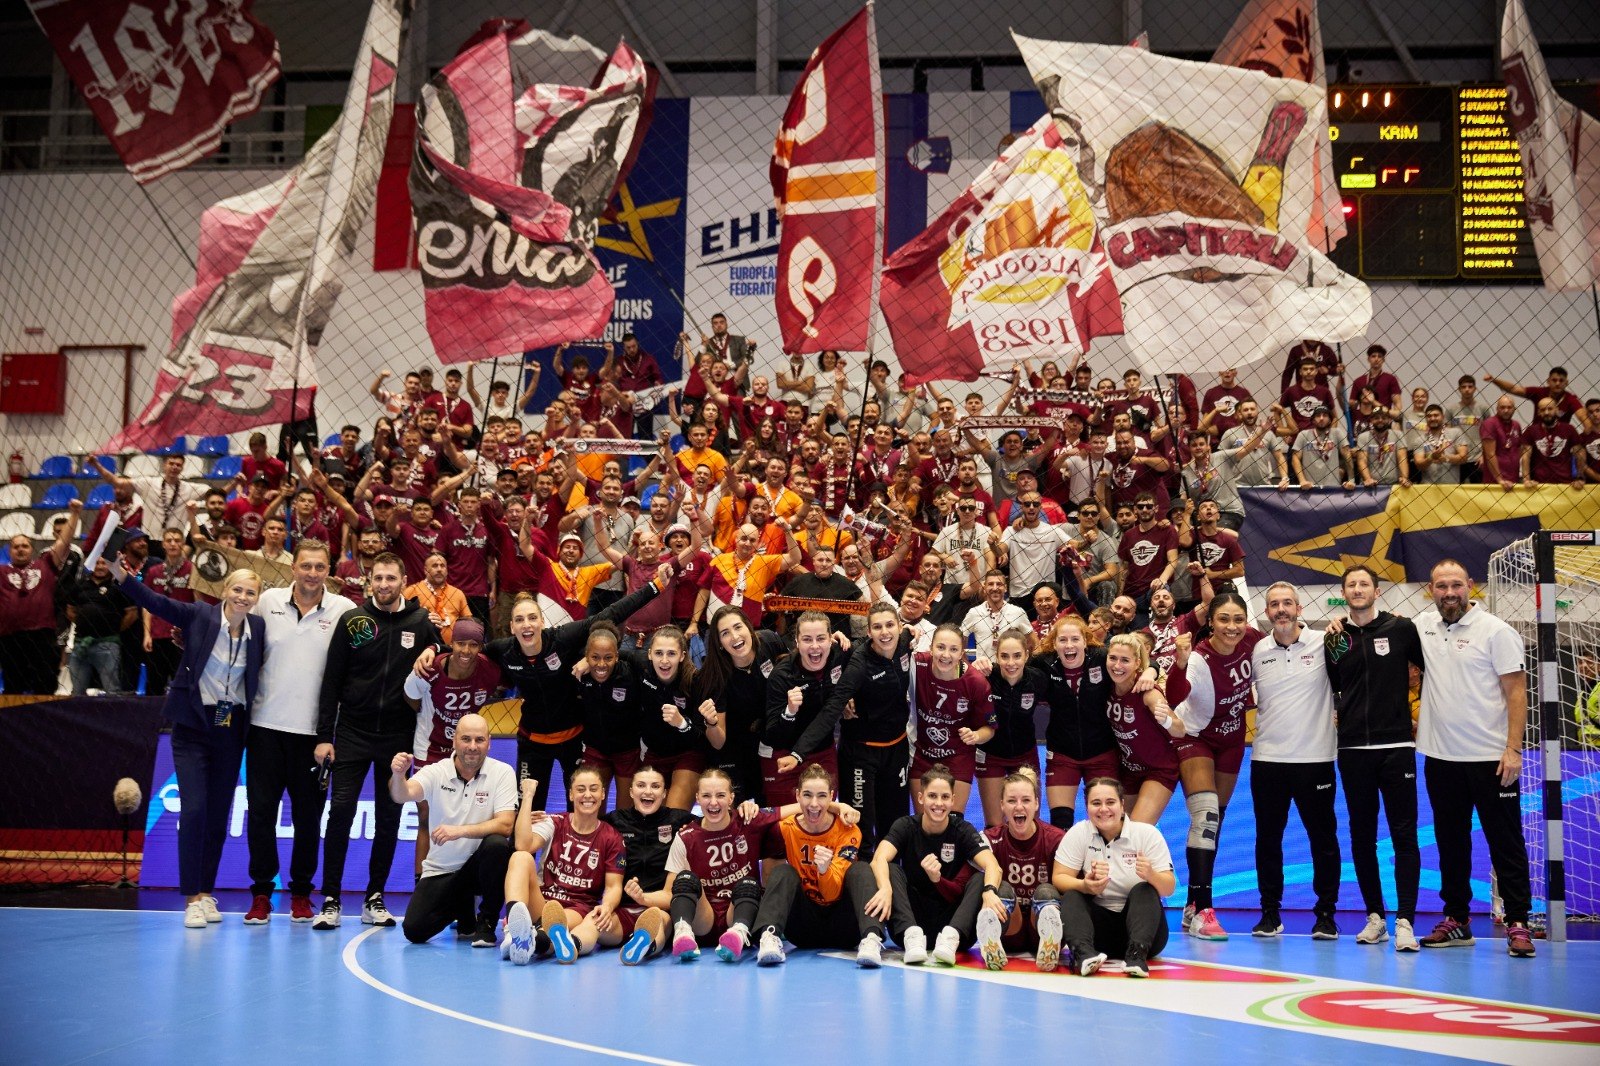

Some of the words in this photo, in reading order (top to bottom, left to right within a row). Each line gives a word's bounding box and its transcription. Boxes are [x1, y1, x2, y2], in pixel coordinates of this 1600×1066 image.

[1380, 125, 1418, 140] KRIM
[1262, 657, 1278, 665] Kempa
[1229, 659, 1251, 687] 10
[444, 691, 472, 711] 22
[936, 691, 948, 710] 7
[853, 768, 866, 808] Kempa
[558, 841, 590, 866] 17
[706, 843, 735, 867] 20
[699, 861, 753, 888] SUPERBET
[1006, 862, 1036, 885] 88
